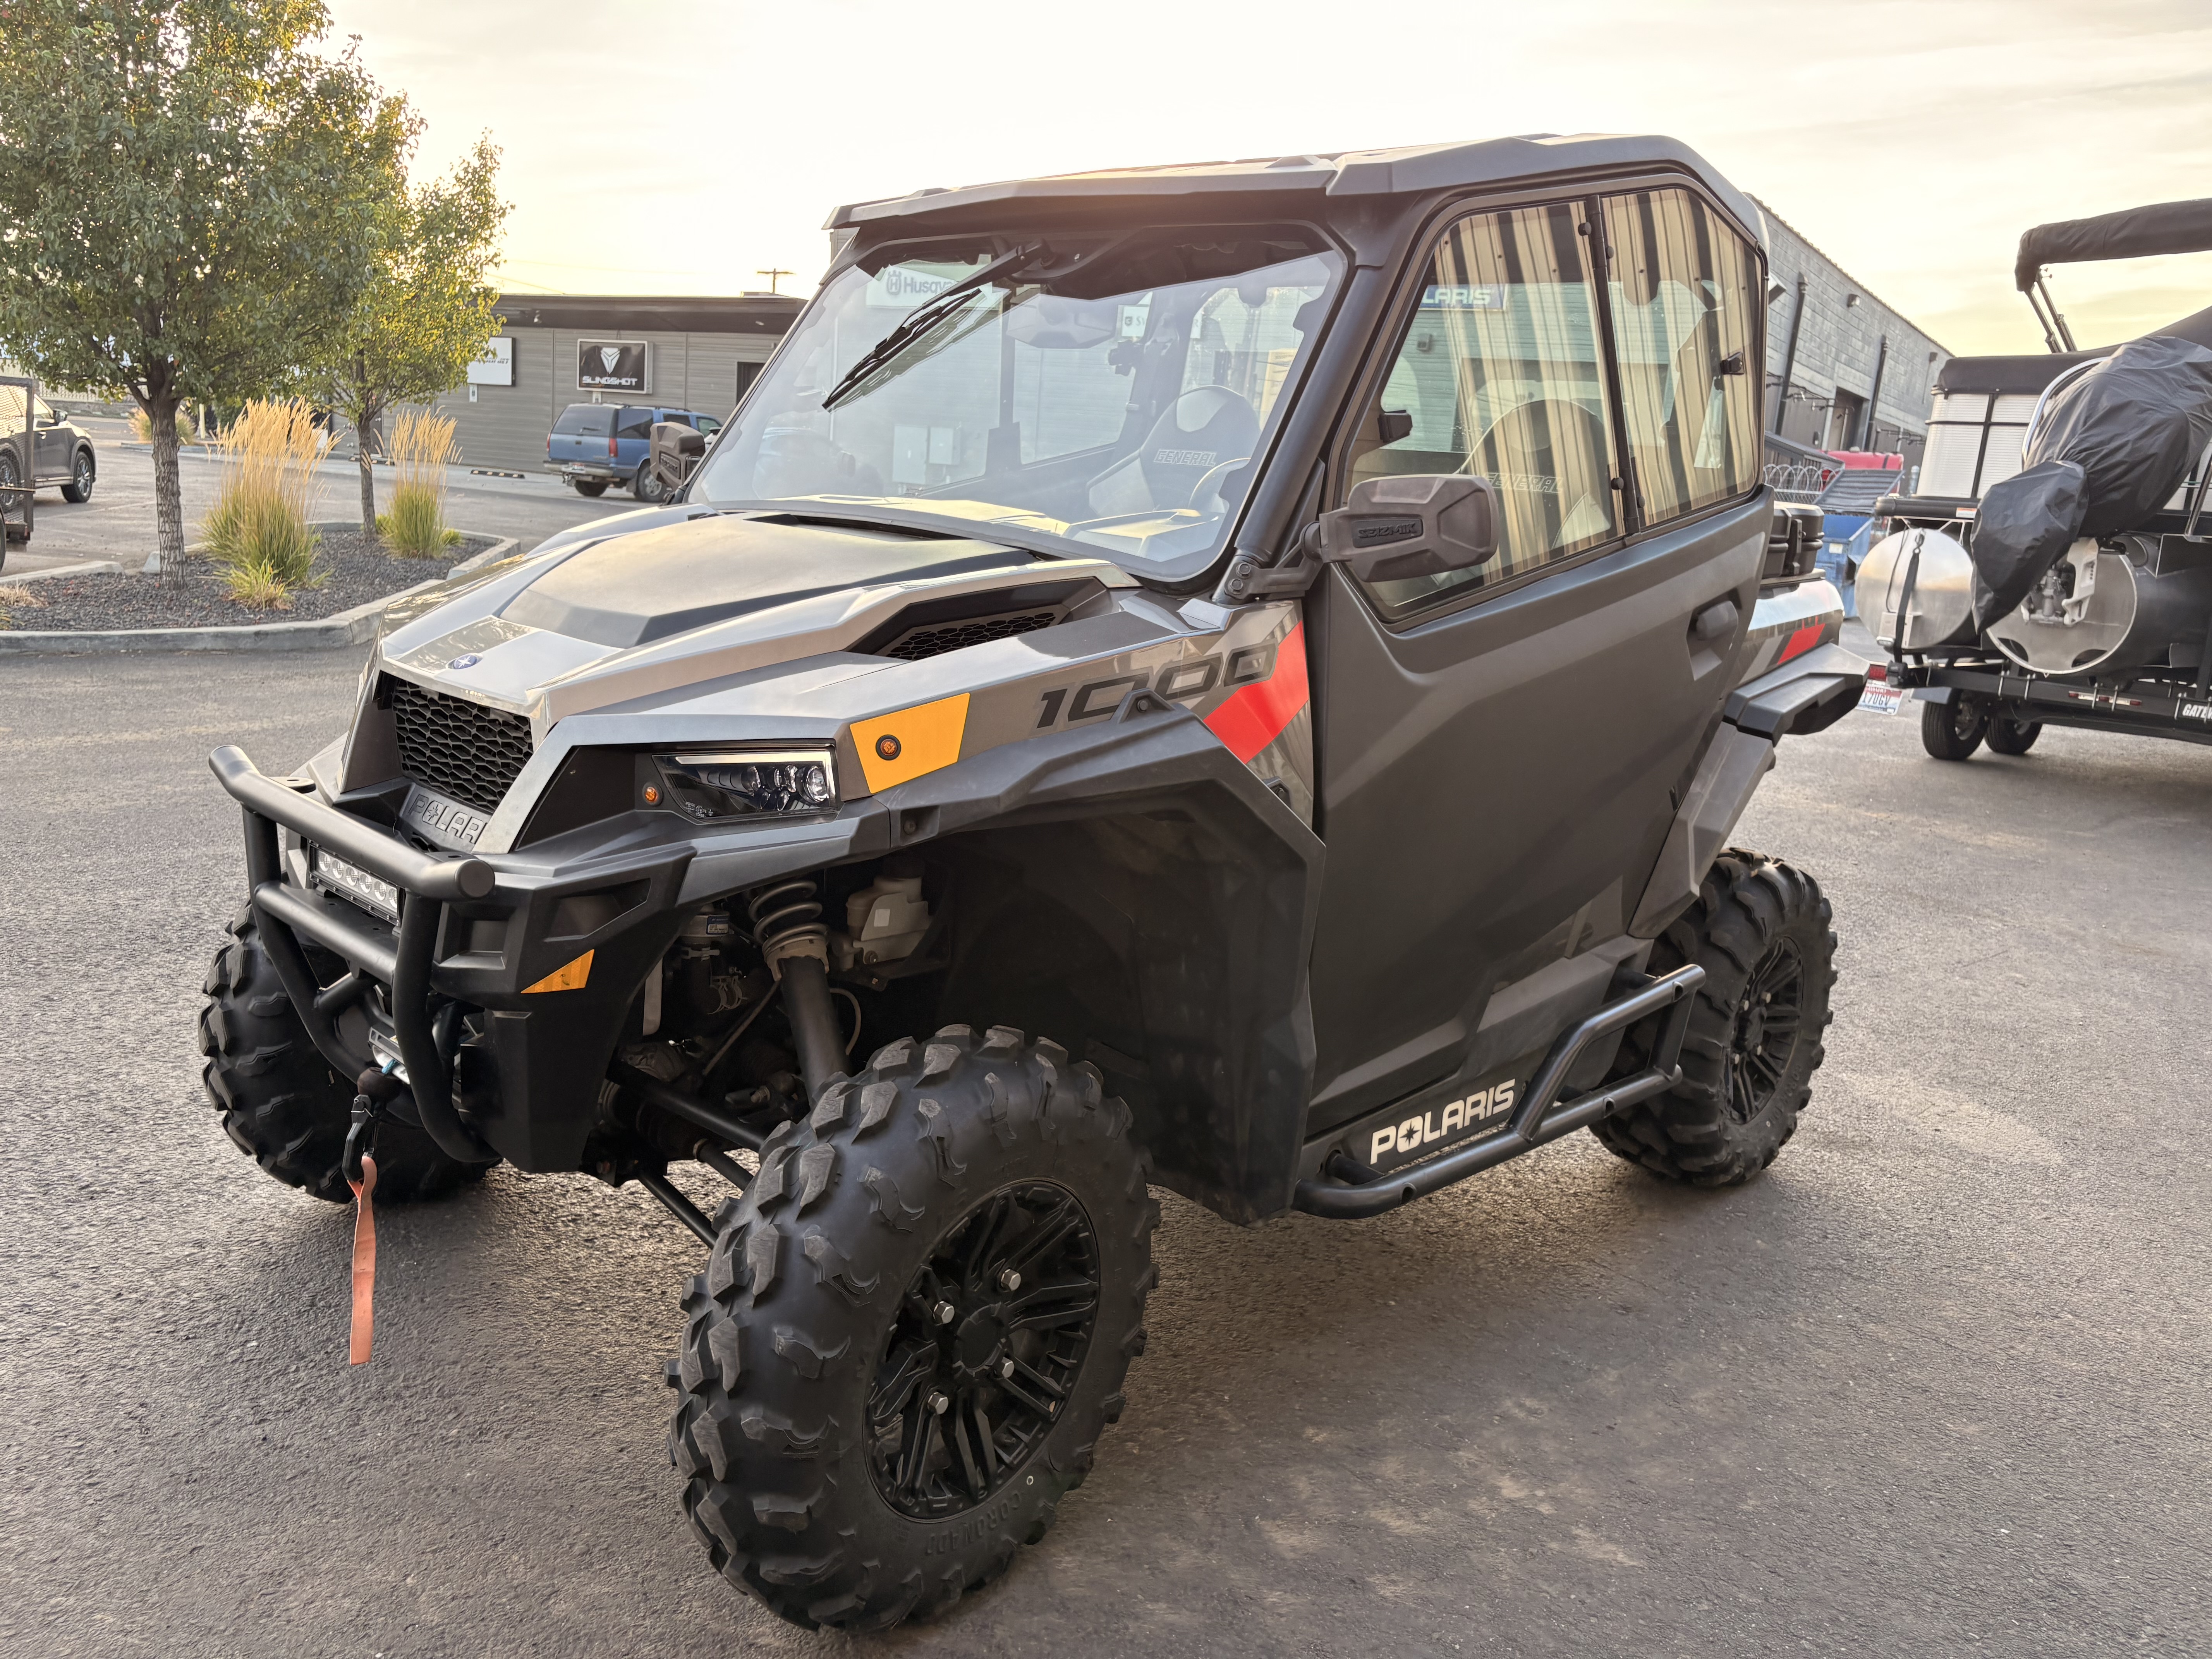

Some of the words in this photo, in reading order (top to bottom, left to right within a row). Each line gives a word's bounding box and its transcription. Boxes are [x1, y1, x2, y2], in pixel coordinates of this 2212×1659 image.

[903, 276, 953, 295] Husqva
[1421, 289, 1492, 305] LARIS
[582, 375, 638, 386] SLINGSHOT
[1153, 449, 1218, 467] GENERAL
[1035, 640, 1279, 730] 1000
[407, 793, 488, 845] POLAR
[1370, 1078, 1516, 1165] POLARIS
